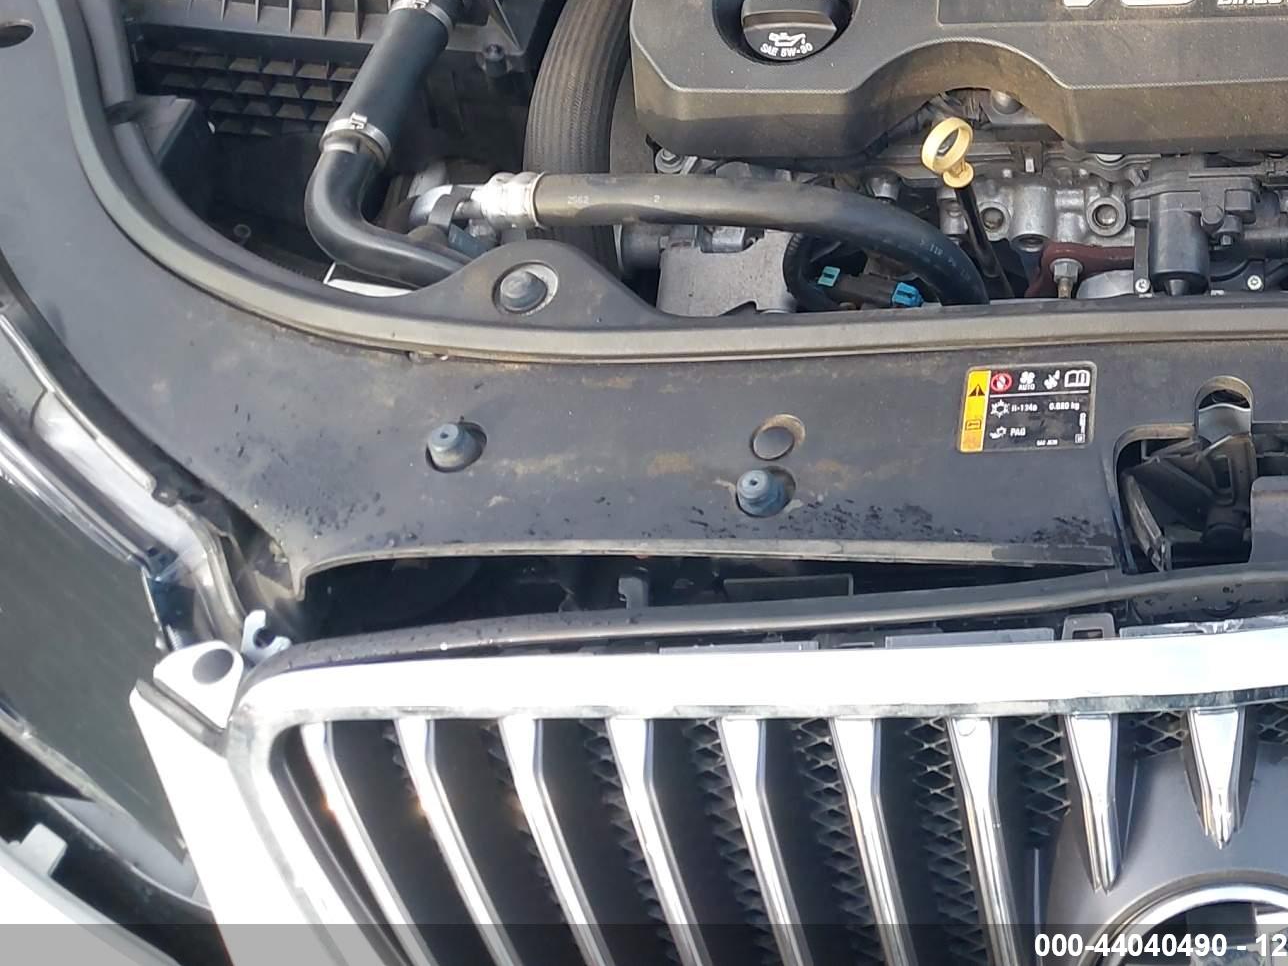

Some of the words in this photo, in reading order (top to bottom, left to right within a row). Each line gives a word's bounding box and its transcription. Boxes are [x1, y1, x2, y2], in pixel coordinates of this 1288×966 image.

[760, 44, 779, 57] SAE
[781, 43, 813, 57] 5W-30
[1018, 383, 1036, 391] AUTO
